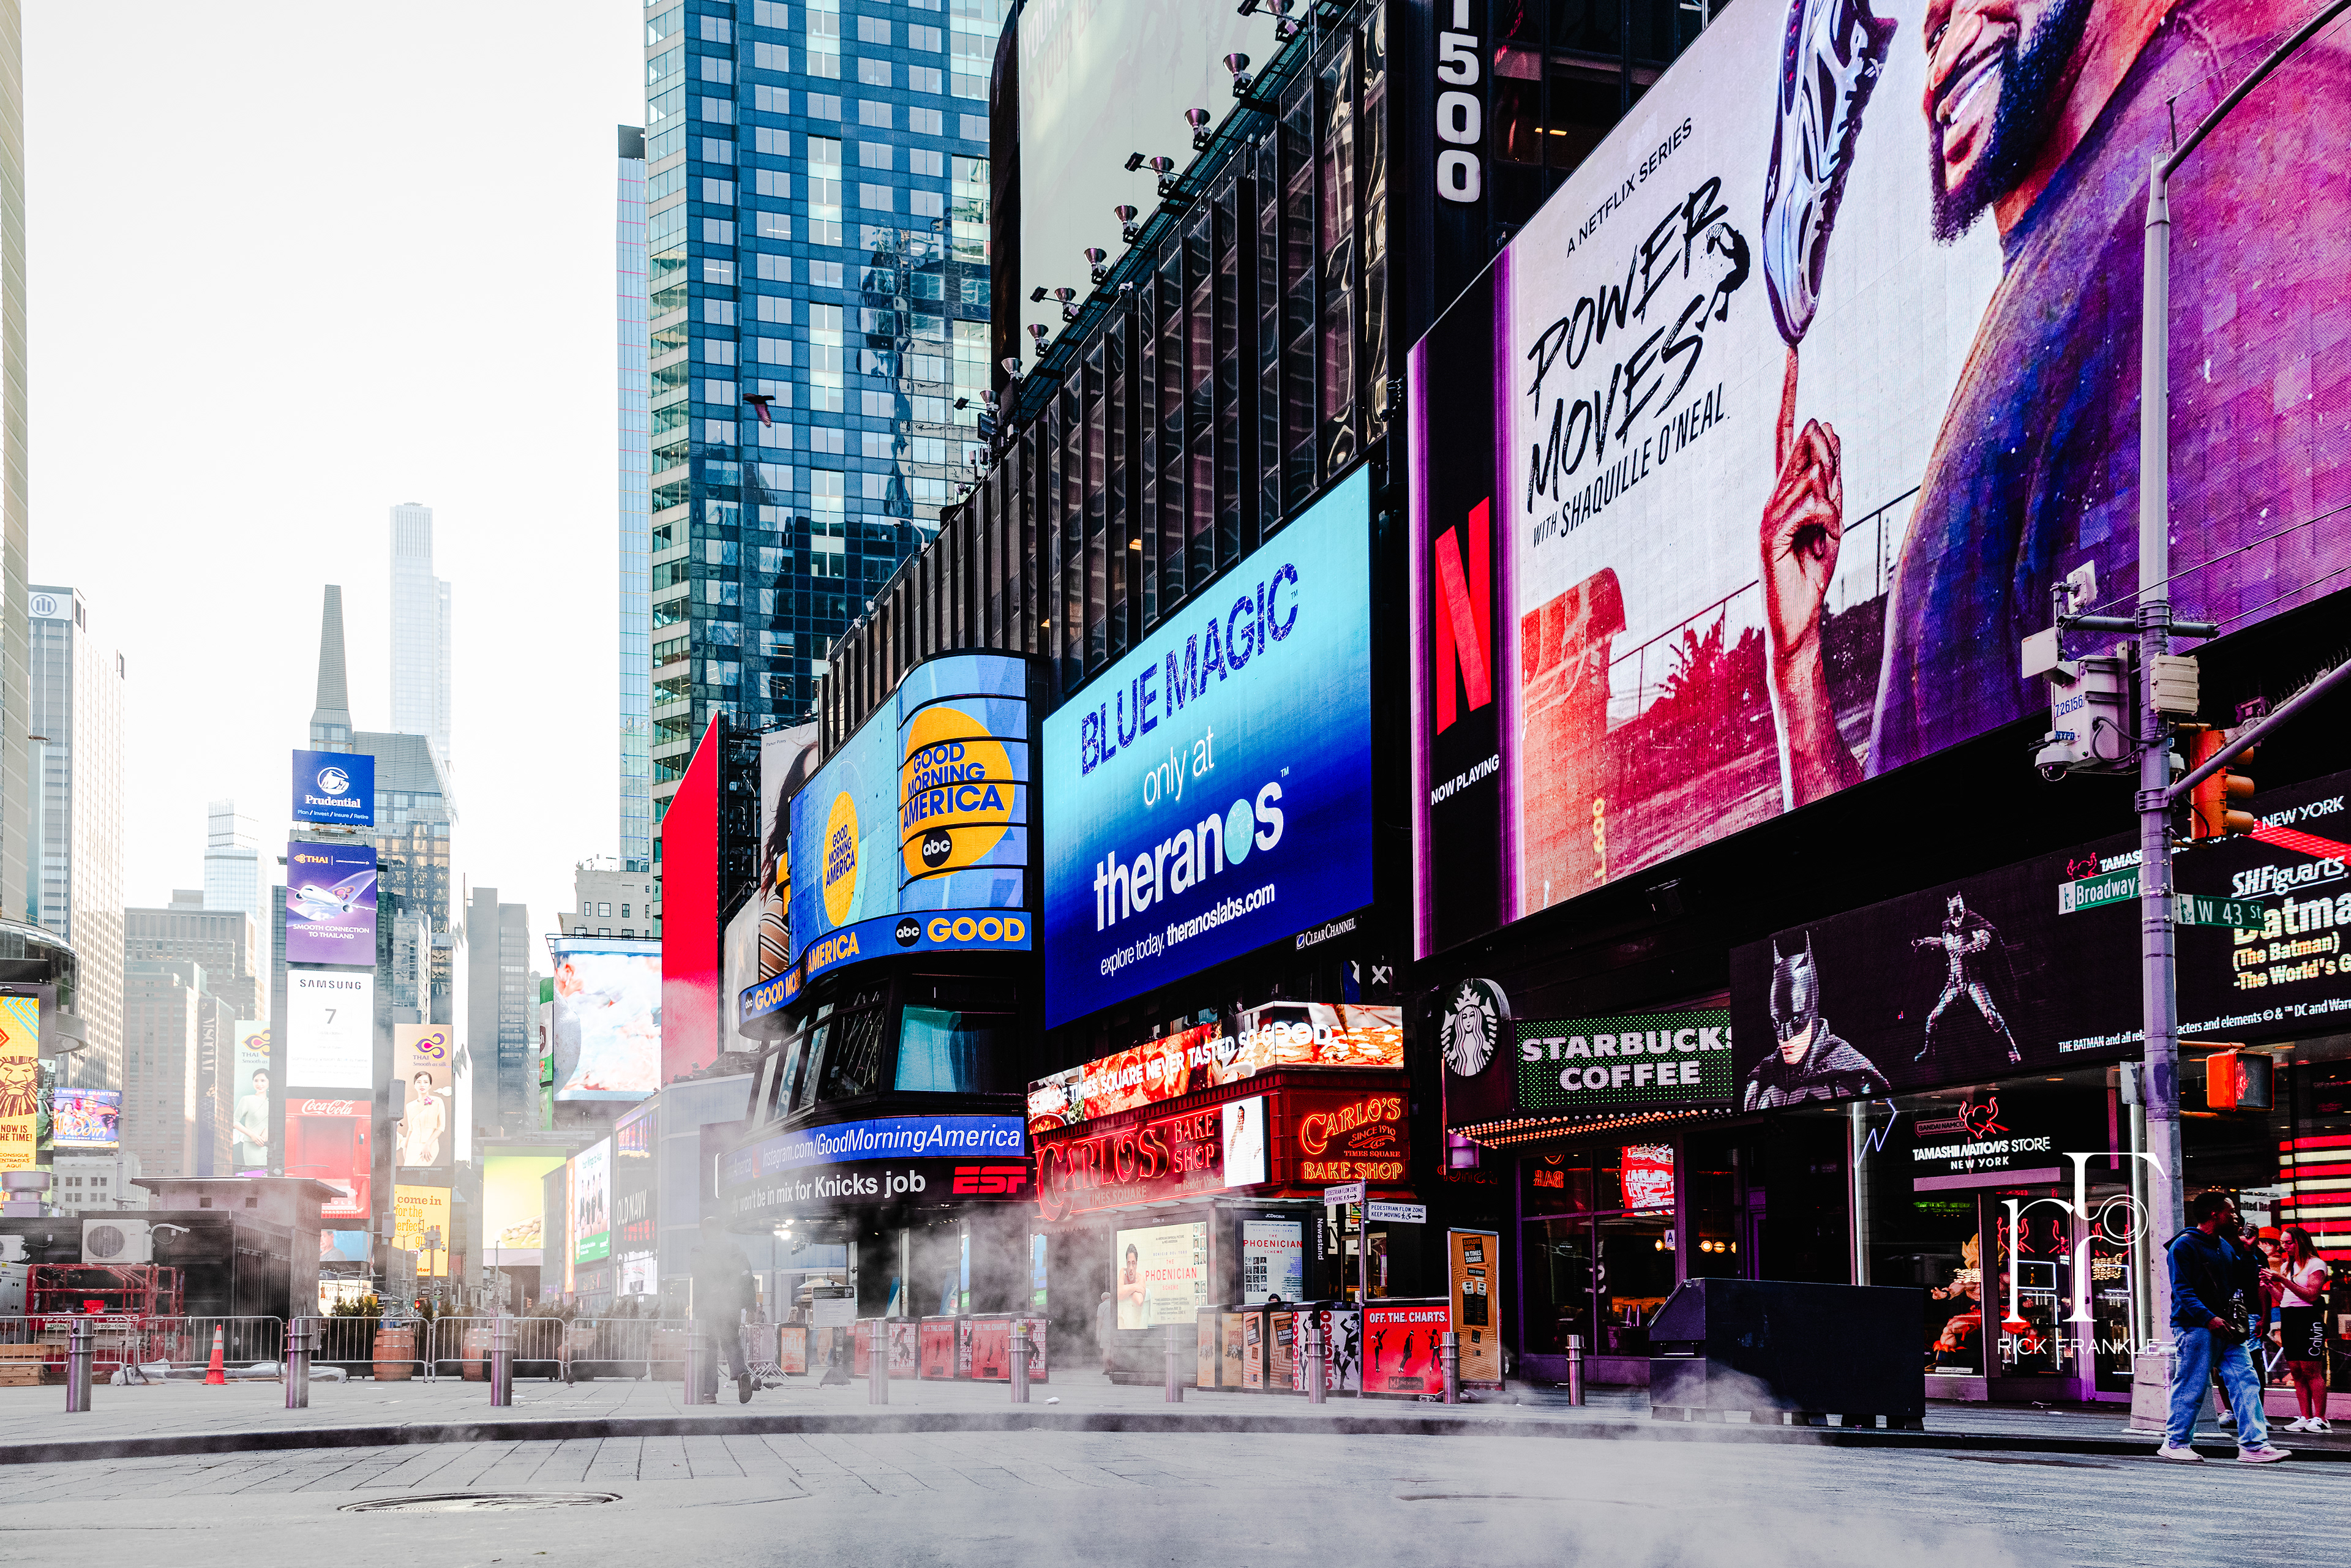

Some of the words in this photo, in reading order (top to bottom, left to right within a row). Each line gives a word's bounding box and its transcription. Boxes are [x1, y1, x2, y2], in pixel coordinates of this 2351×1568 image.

[1436, 0, 1480, 203] 1500
[1567, 237, 1575, 257] A
[1579, 174, 1635, 240] NETFLIX
[1640, 117, 1692, 183] SERIES
[1528, 177, 1728, 421] POWER
[1528, 294, 1705, 514] MOVES
[1533, 511, 1557, 548] WITH
[1561, 436, 1652, 538] SHAQUILLE
[1082, 662, 1158, 778] BLUE
[1166, 563, 1299, 719] MAGIC
[2055, 731, 2075, 740] NYPD
[913, 741, 965, 774] GOOD
[1144, 746, 1187, 806] only
[1193, 726, 1214, 778] at
[908, 763, 985, 796] MORNING
[1431, 778, 1455, 806] NOW
[1457, 754, 1499, 789] PLAYING
[306, 795, 361, 808] Prudential
[903, 785, 1005, 833] AMERICA
[2262, 809, 2297, 830] NEW
[2297, 795, 2344, 822] YORK
[832, 824, 848, 845] GOOD
[923, 836, 950, 857] abc
[828, 836, 852, 865] MORNING
[1094, 781, 1284, 931] theranos
[825, 853, 855, 889] AMERICA
[2076, 876, 2135, 906] Broadway
[2198, 900, 2213, 923] W
[2223, 904, 2242, 926] 43
[2250, 906, 2261, 920] St
[896, 926, 919, 938] abc
[928, 917, 1025, 941] GOOD
[1101, 946, 1134, 977] explore
[1136, 932, 1164, 961] today.
[1167, 883, 1275, 946] theranoslabs.com
[806, 932, 860, 975] AMERICA
[2233, 948, 2267, 972] (The
[2269, 931, 2341, 961] Batman)
[300, 979, 361, 989] SAMSUNG
[2270, 958, 2336, 986] World's
[755, 983, 784, 1011] GOOD
[325, 1008, 336, 1024] 7
[2203, 1018, 2220, 1030] and
[2221, 1012, 2262, 1028] elements
[2294, 1003, 2308, 1017] DC
[2309, 1000, 2328, 1015] and
[2058, 1041, 2072, 1053] THE
[2073, 1035, 2104, 1051] BATMAN
[2105, 1034, 2120, 1046] and
[2121, 1032, 2131, 1044] all
[1069, 1078, 1098, 1104] TIMES
[1101, 1065, 1144, 1096] SQUARE
[1146, 1051, 1185, 1079] NEVER
[1188, 1036, 1235, 1068] TASTED
[1238, 1031, 1257, 1052] SO
[1261, 1021, 1332, 1048] GOOD
[1559, 1060, 1701, 1091] COFFEE
[1, 1124, 19, 1133] NOW
[53, 1115, 108, 1138] Aladdin
[1174, 1113, 1215, 1144] BAKE
[1302, 1097, 1401, 1155] CARLO'S
[1352, 1129, 1376, 1141] SINCE
[1379, 1124, 1396, 1136] 1910
[763, 1124, 1021, 1169] Instagram.com/GoodMorningAmerica
[1174, 1144, 1215, 1174] SHOP
[1913, 1145, 1960, 1161] TAMASHII
[1960, 1140, 2009, 1157] NATIONS
[2012, 1137, 2051, 1152] STORE
[1303, 1162, 1351, 1180] BAKE
[1354, 1161, 1403, 1180] SHOP
[1951, 1159, 1974, 1170] NEW
[1978, 1157, 2009, 1168] YORK
[740, 1190, 756, 1212] won't
[757, 1188, 765, 1207] be
[767, 1186, 774, 1205] in
[777, 1182, 793, 1204] mix
[795, 1180, 812, 1201] for
[815, 1174, 878, 1198] Knicks
[885, 1170, 926, 1198] job
[1113, 1185, 1147, 1202] SQUARE
[1183, 1179, 1202, 1191] Buddy
[395, 1204, 407, 1216] for
[409, 1206, 422, 1217] the
[430, 1196, 441, 1206] in
[617, 1197, 629, 1226] OLD
[630, 1189, 647, 1221] NAVY
[1146, 1267, 1197, 1281] PHOENICIAN
[1370, 1313, 1387, 1323] OFF.
[1389, 1313, 1407, 1322] THE.
[1409, 1311, 1447, 1322] CHARTS.
[1033, 1333, 1045, 1341] BAD
[2308, 1321, 2322, 1357] Calvin
